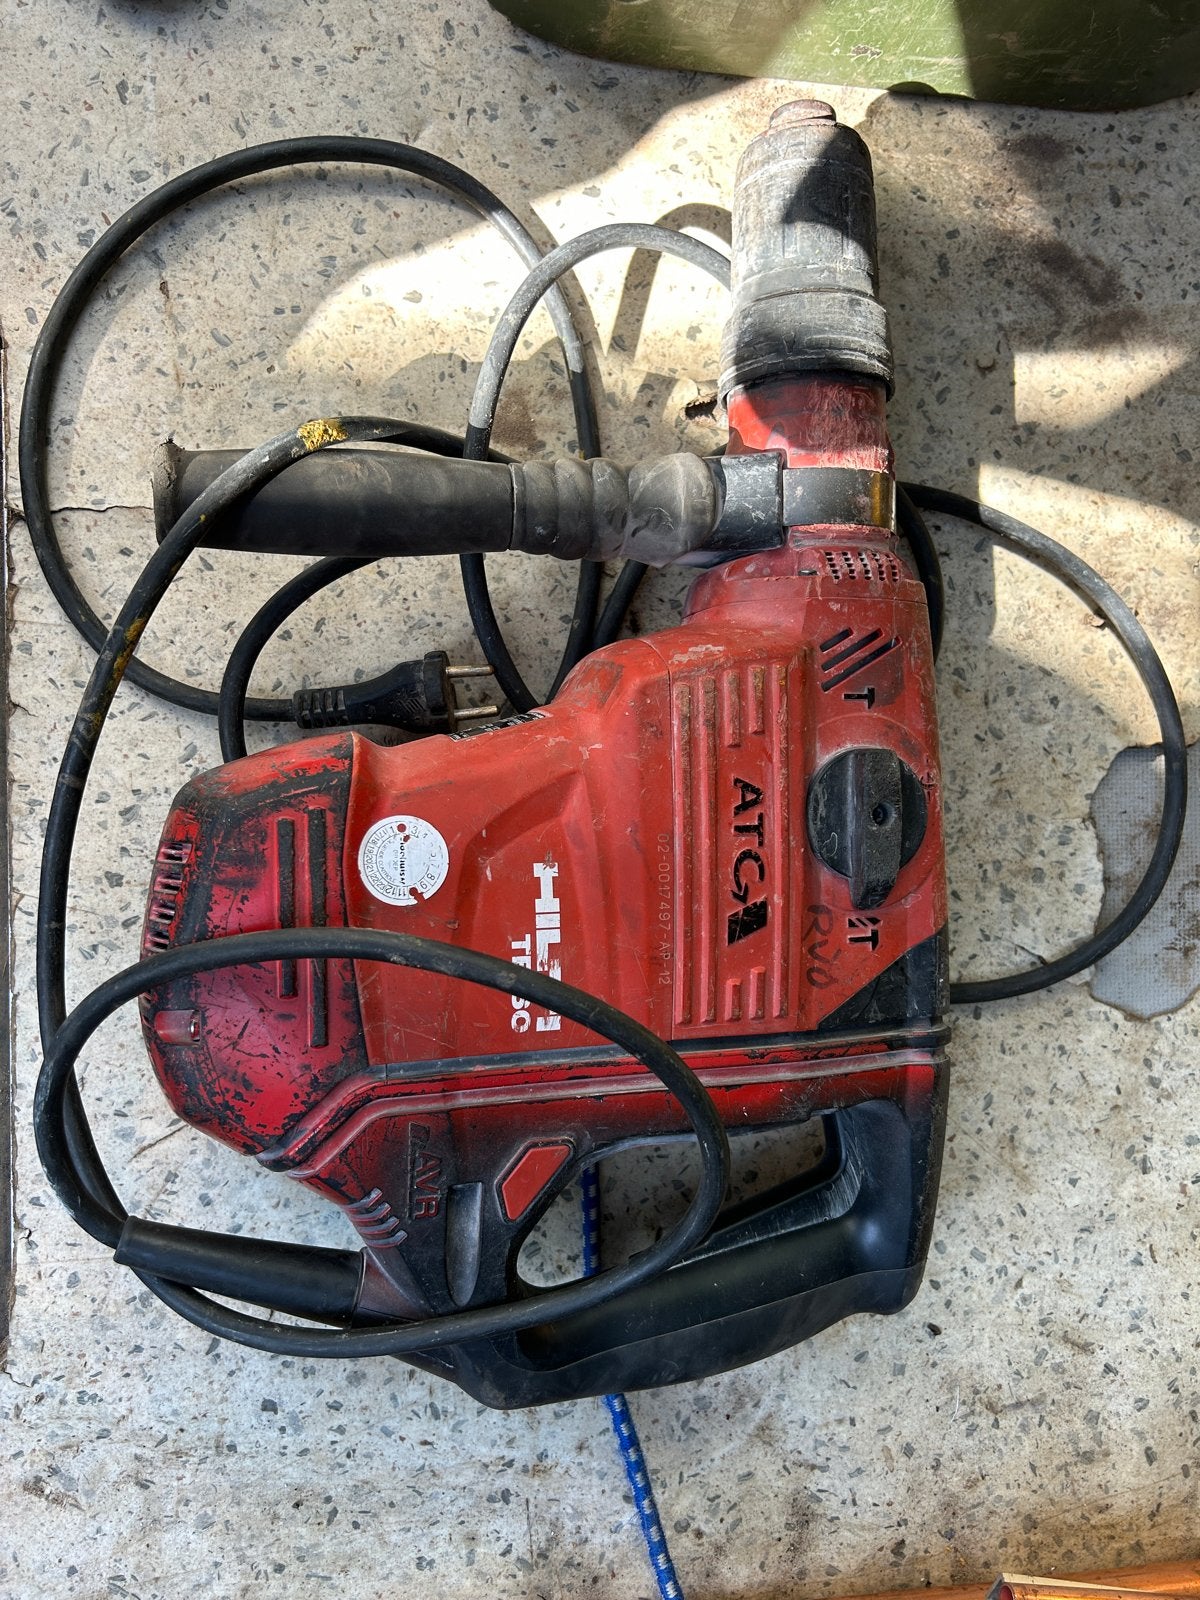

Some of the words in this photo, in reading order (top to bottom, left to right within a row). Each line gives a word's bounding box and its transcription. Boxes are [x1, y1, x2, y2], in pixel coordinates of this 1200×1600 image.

[366, 845, 375, 854] 19
[365, 854, 375, 864] 20
[366, 864, 375, 873] 21
[370, 873, 379, 883] 22
[426, 873, 436, 881] 8
[414, 1150, 442, 1219] AVR
